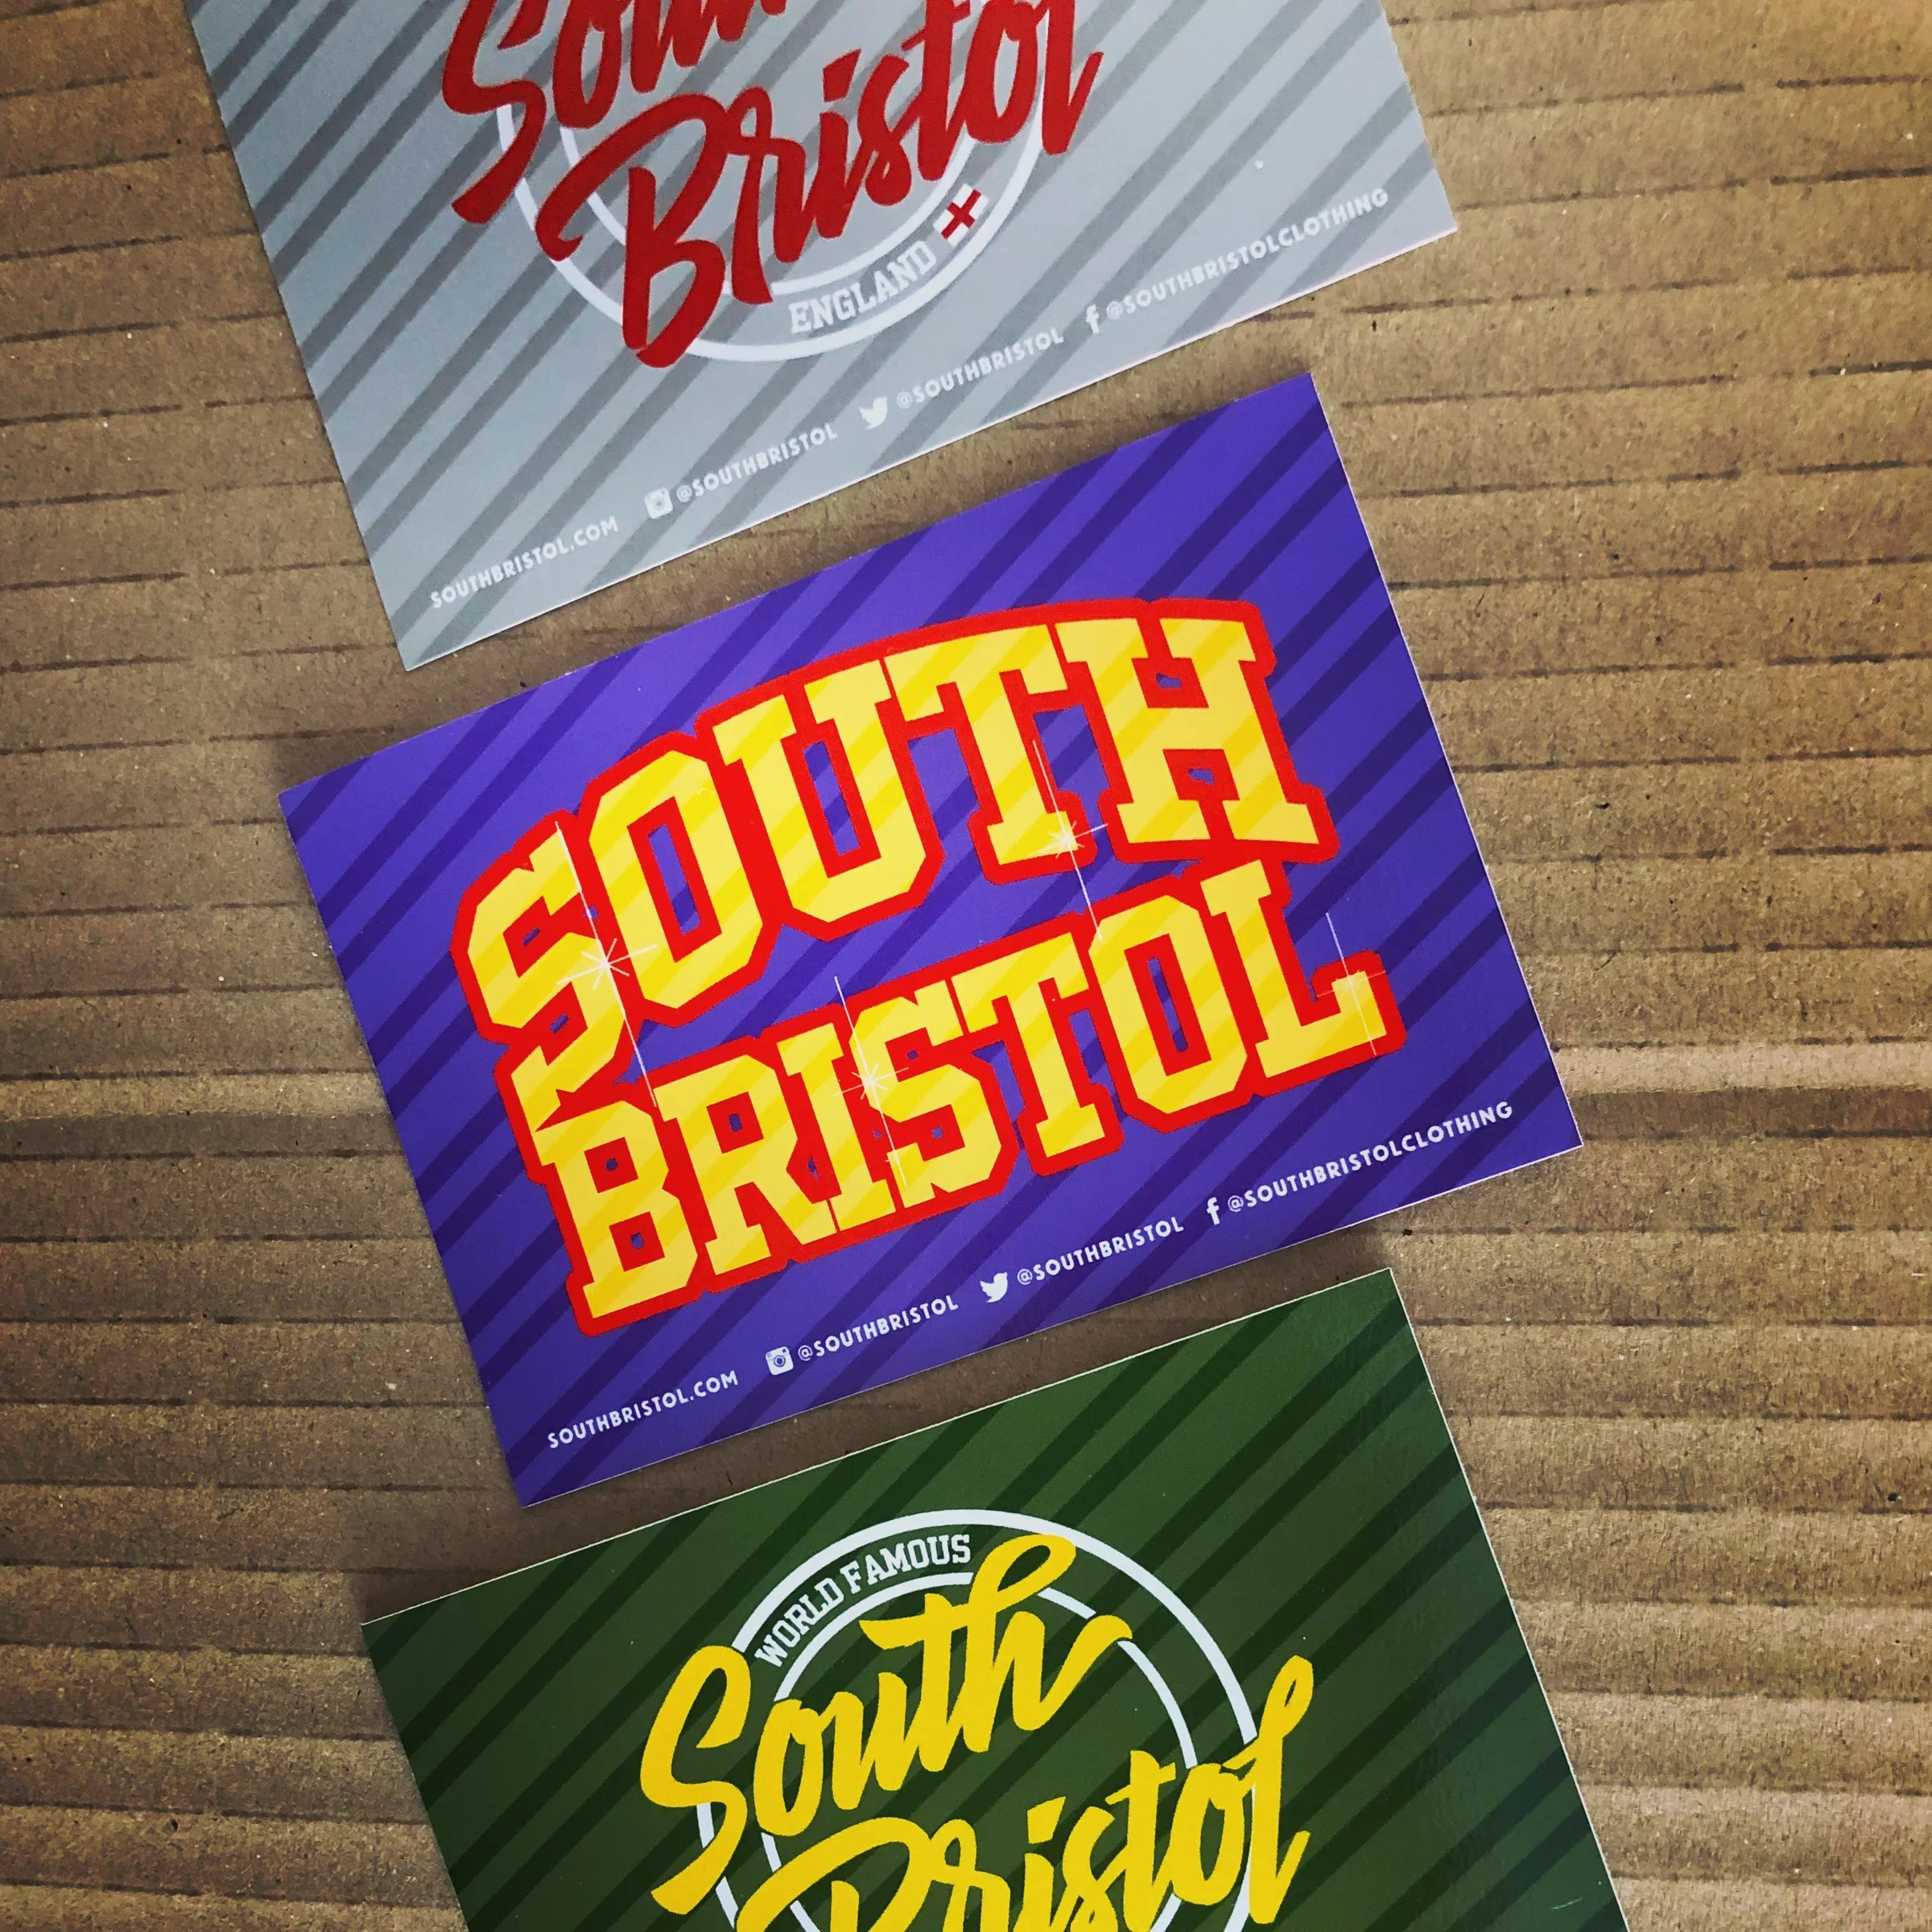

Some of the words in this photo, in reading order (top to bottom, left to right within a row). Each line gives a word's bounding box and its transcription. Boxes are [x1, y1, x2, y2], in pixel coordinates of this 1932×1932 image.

[443, 0, 787, 223] Sou
[535, 0, 1104, 368] Bristol
[788, 240, 937, 334] ENGLAND
[430, 515, 619, 609] SOUTHBRISTOL.COM
[675, 424, 838, 504] @SOUTHBRISTOL
[895, 328, 1064, 410] @SOUTHBRISTOL
[1105, 188, 1389, 321] @SOUTHBRISTOLCLOTHING
[465, 616, 1320, 1131] SOUTH
[533, 859, 1388, 1319] BRISTOL
[547, 1370, 739, 1449] SOUTHBRISTOL.COM
[798, 1295, 960, 1362] @SOUTHBRISTOL
[1017, 1216, 1185, 1286] @SOUTHBRISTOL
[1228, 1101, 1513, 1212] @SOUTHBRISTOLCLOTHING
[640, 1534, 1133, 1914] South
[754, 1578, 844, 1668] WORLD
[840, 1534, 972, 1595] FAMOUS
